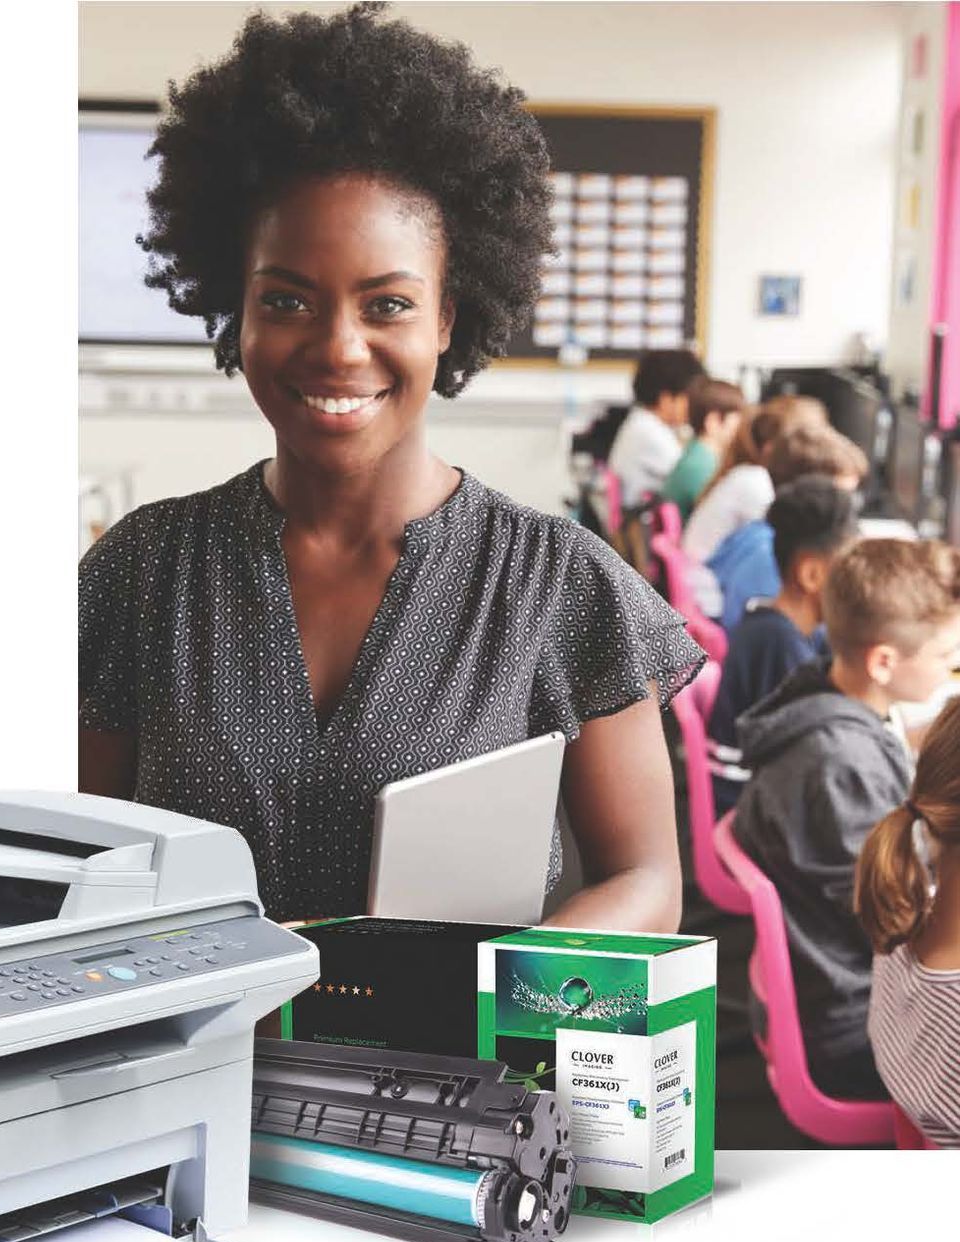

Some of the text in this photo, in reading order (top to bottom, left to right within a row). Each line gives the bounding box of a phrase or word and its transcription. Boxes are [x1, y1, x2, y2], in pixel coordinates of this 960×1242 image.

[571, 1050, 614, 1065] CLOVER
[654, 1050, 678, 1069] CLOVER
[571, 1078, 620, 1092] CF361X(J)
